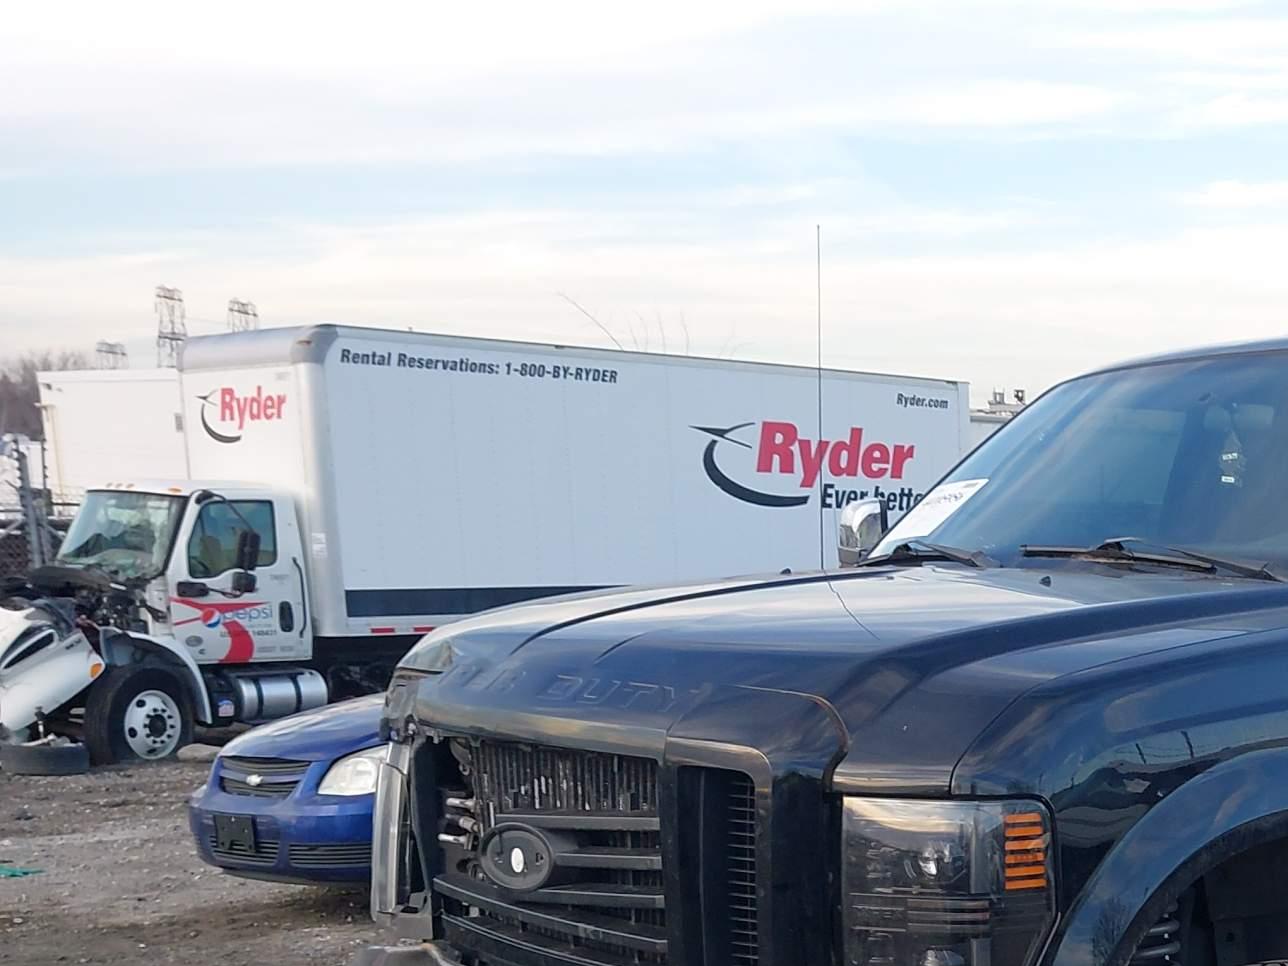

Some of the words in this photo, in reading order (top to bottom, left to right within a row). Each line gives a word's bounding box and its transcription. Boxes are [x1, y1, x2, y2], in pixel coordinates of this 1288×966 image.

[339, 349, 392, 367] Rental
[397, 353, 500, 375] Reservations:
[504, 362, 618, 384] 1-800-BY-RYDER
[220, 385, 287, 430] Ryder
[896, 393, 949, 410] Ryder.com
[756, 420, 916, 489] Ryder
[821, 483, 870, 510] Ever
